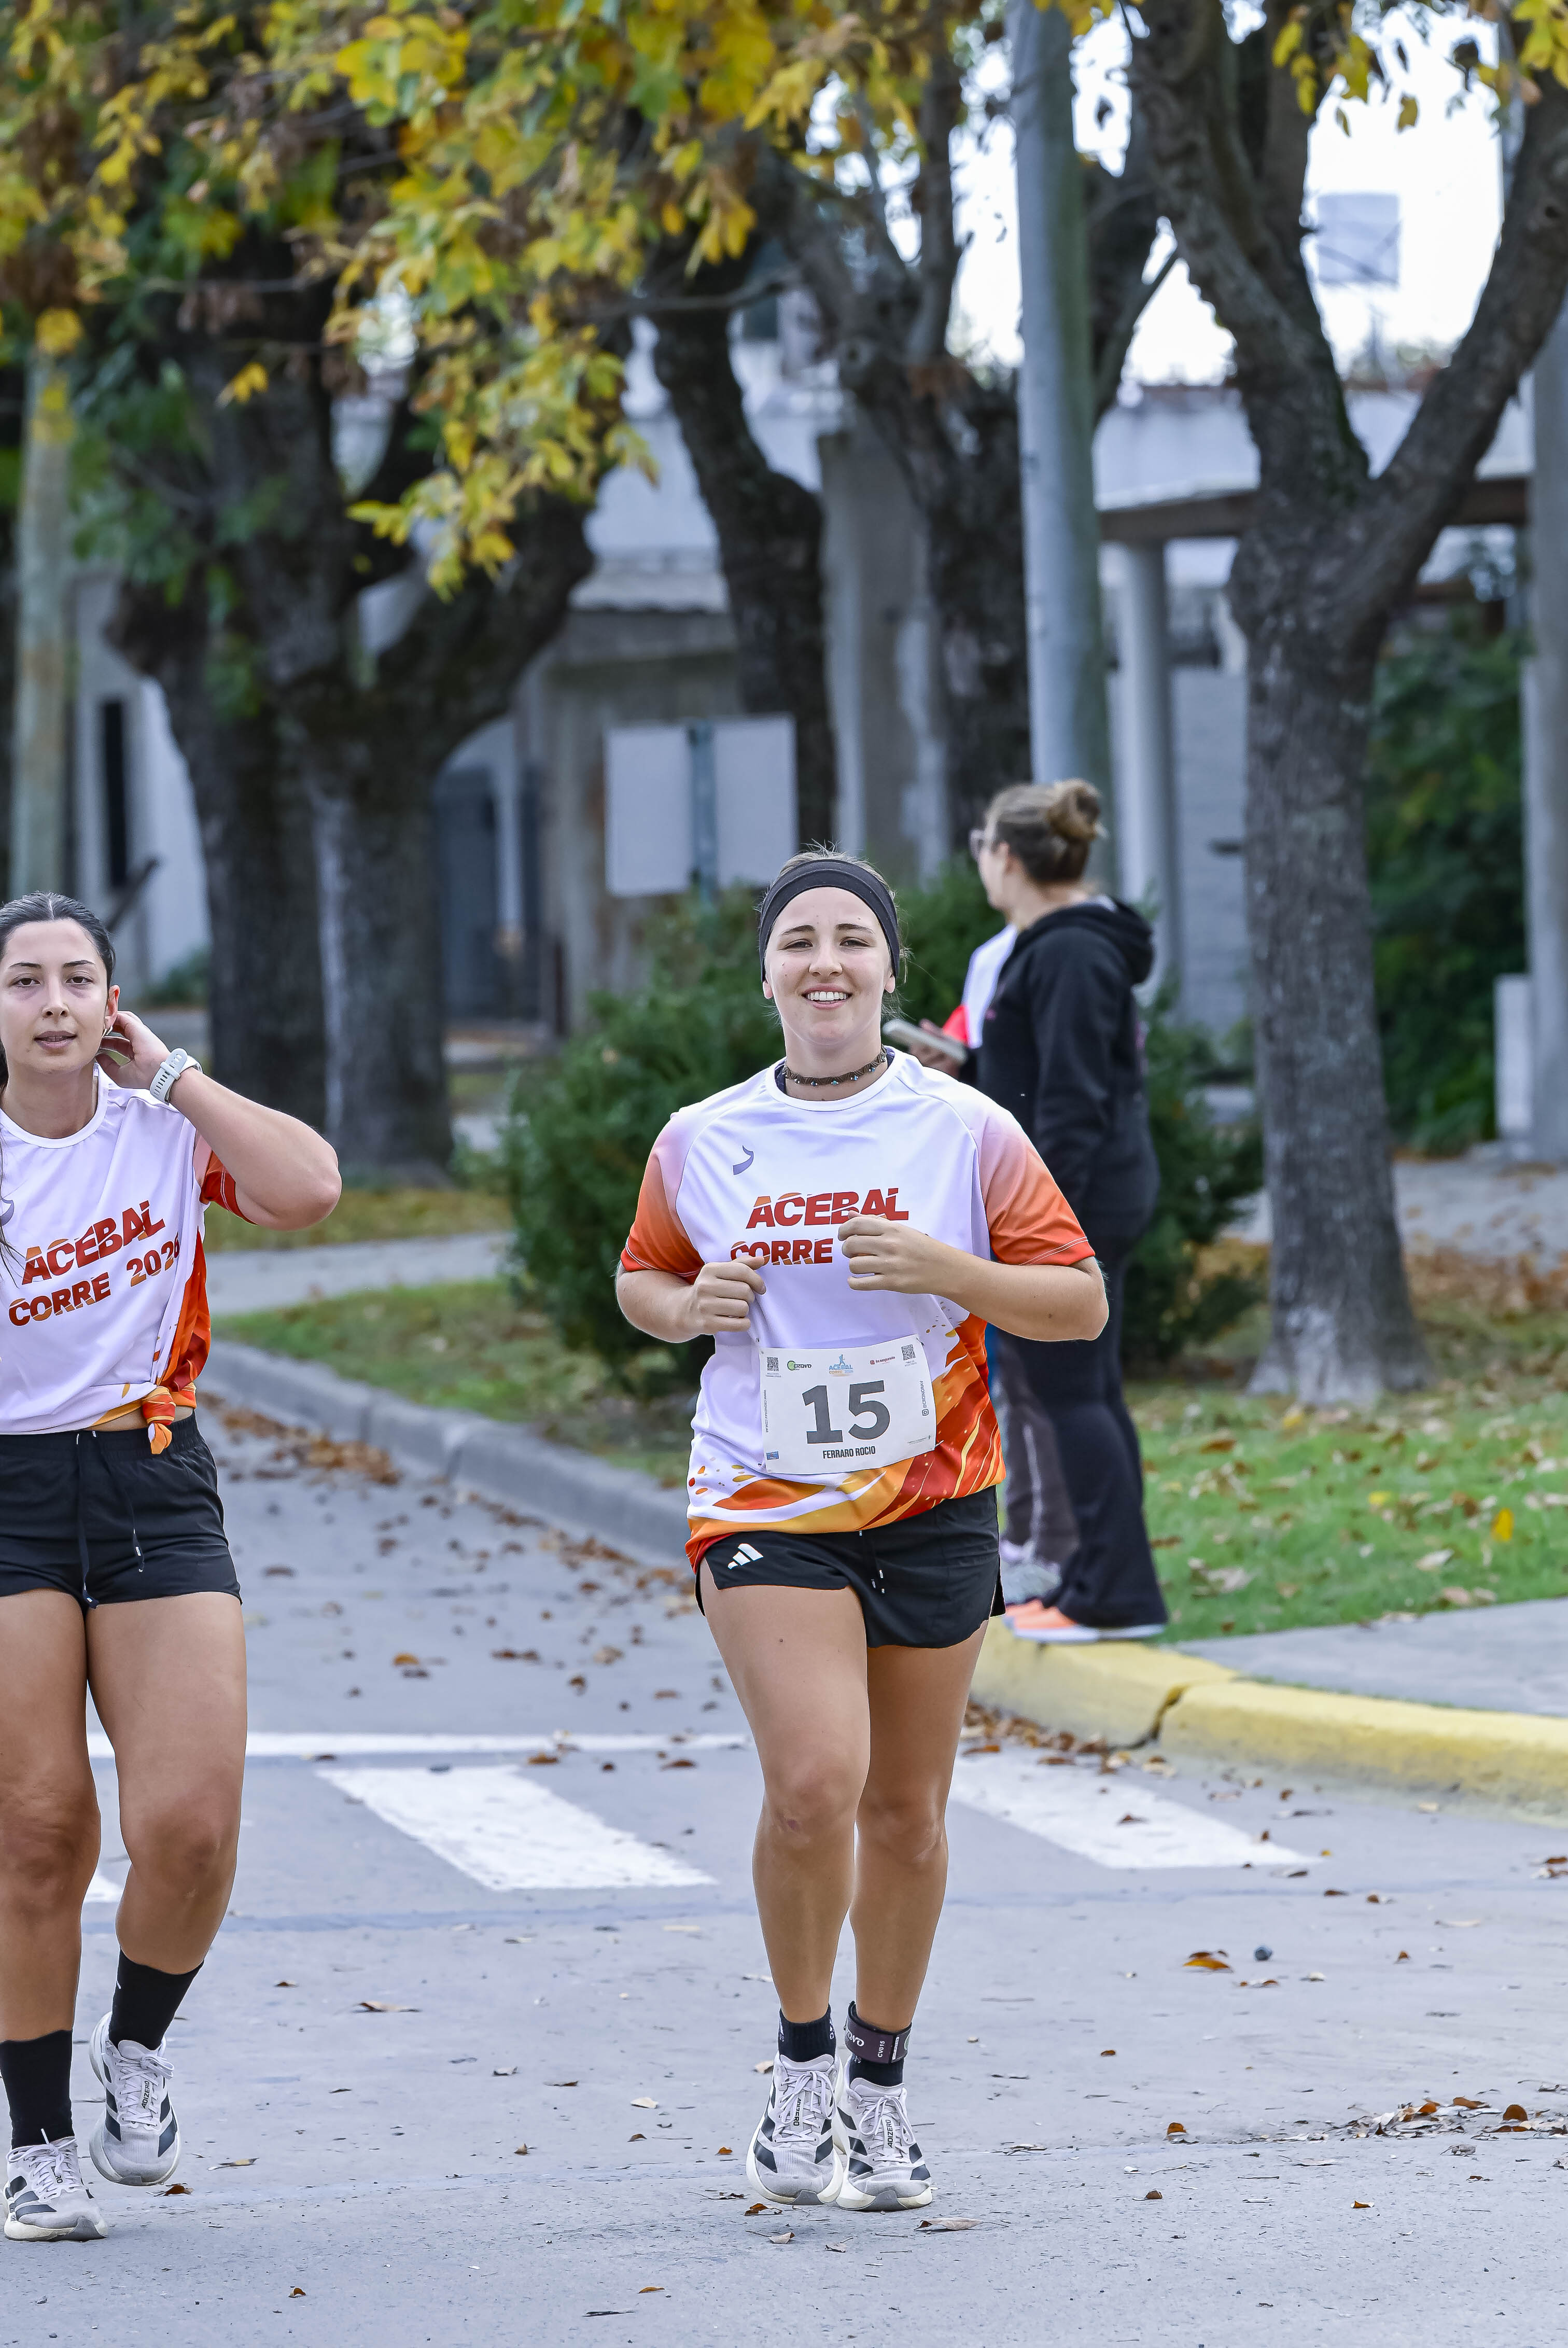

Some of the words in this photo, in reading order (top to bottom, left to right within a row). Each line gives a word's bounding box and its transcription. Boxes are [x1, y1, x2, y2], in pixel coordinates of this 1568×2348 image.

[746, 1187, 909, 1229] ACEBAL
[22, 1200, 166, 1285] ACEBAL
[730, 1238, 833, 1266] CORRE
[8, 1272, 111, 1326] CORRE
[802, 1380, 890, 1444] 15
[823, 1448, 854, 1459] FERRARO
[855, 1446, 876, 1457] ROCIO
[141, 2080, 150, 2109] ADIZERO
[885, 2119, 893, 2148] ADIZERO
